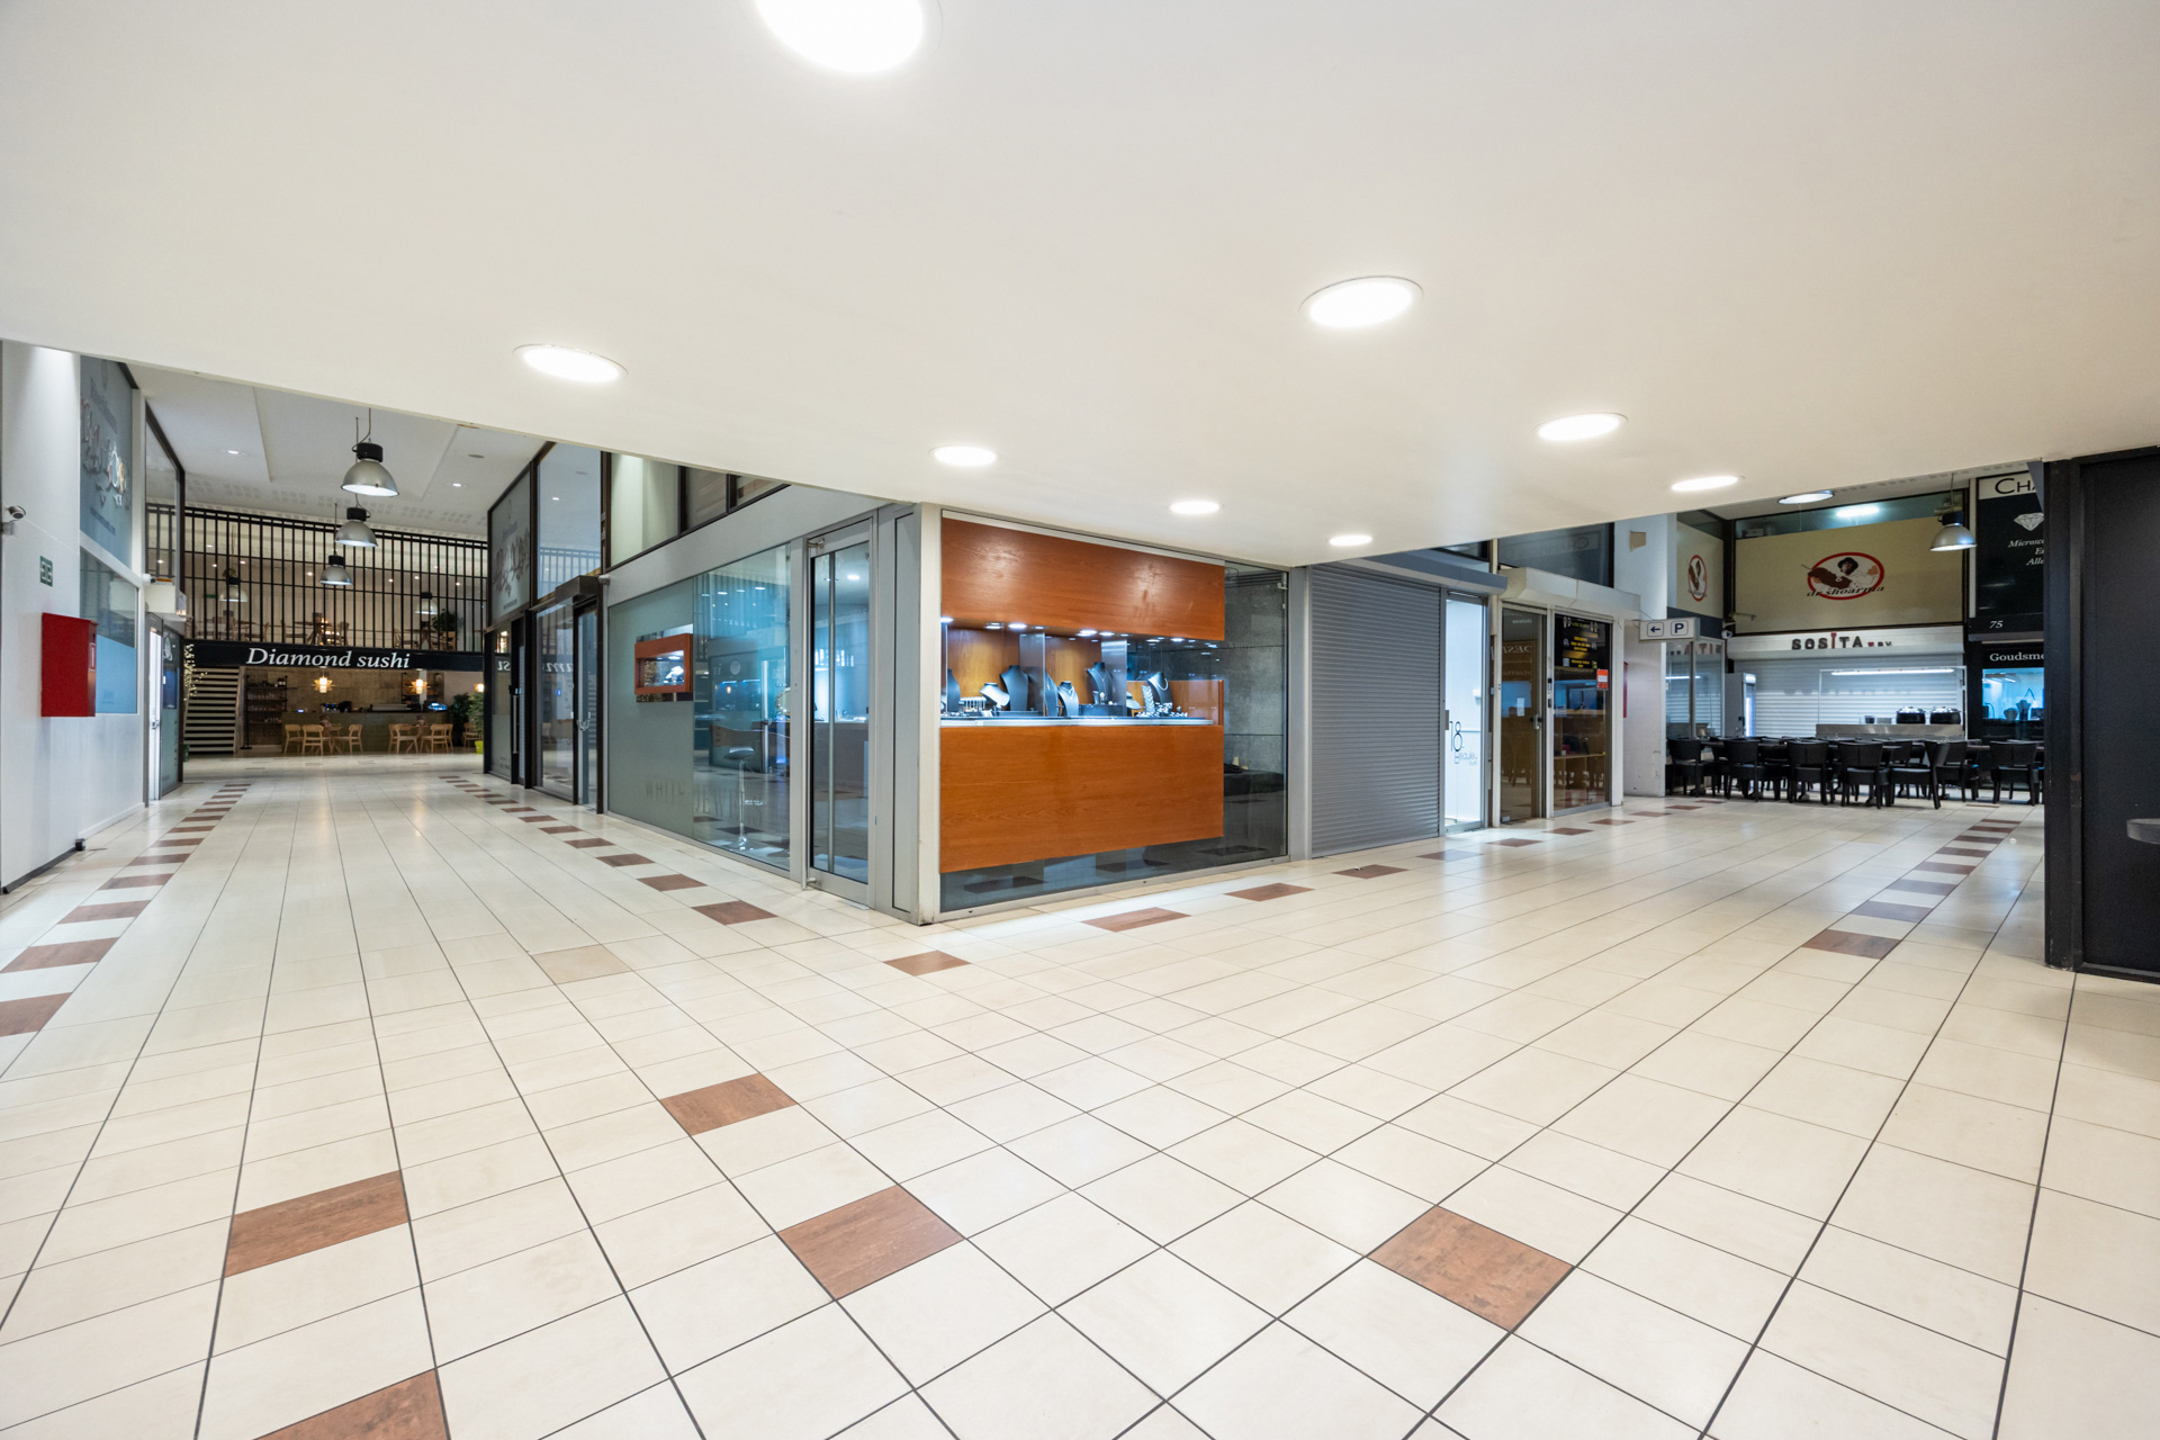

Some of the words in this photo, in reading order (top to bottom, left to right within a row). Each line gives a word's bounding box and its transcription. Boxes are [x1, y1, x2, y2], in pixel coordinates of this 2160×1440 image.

[1674, 623, 1684, 633] P
[1989, 620, 2004, 629] 75
[1791, 632, 1863, 650] SOSITA
[246, 647, 352, 667] Diamond
[356, 652, 410, 669] sushi
